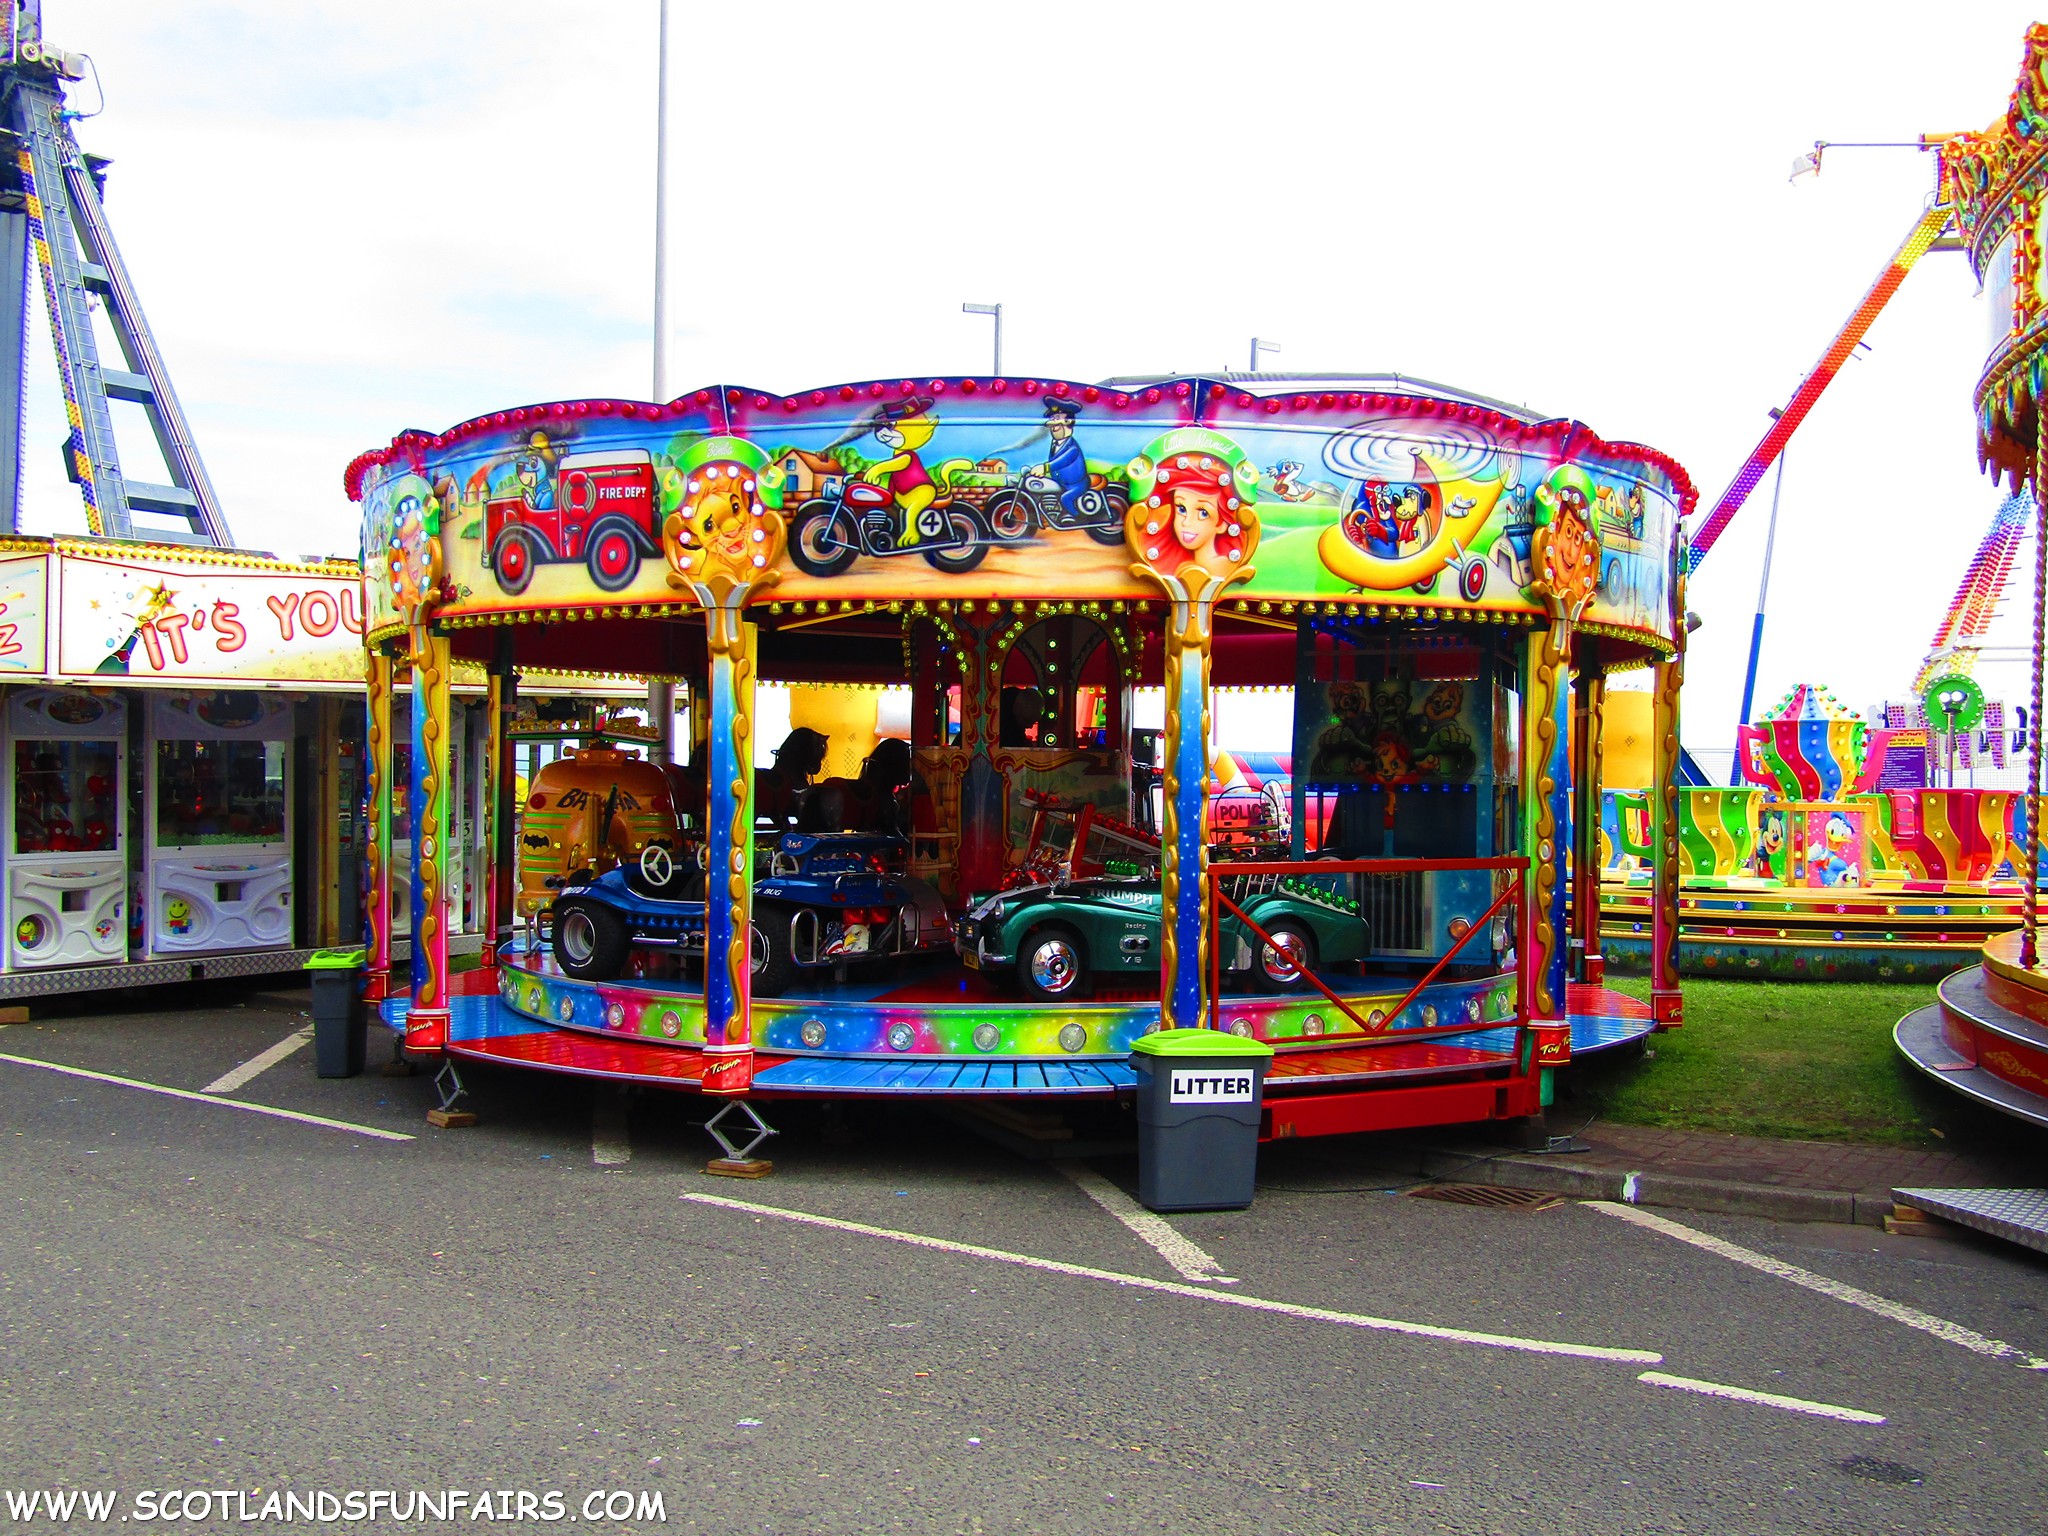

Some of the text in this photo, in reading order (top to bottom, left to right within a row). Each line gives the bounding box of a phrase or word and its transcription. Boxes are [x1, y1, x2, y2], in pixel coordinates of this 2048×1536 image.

[600, 486, 622, 500] FIRE
[1081, 493, 1095, 511] 6
[921, 512, 940, 533] 4
[140, 602, 248, 672] IT'S
[1219, 802, 1272, 821] POLICE
[1089, 887, 1154, 906] TRIUMPH
[1173, 1077, 1250, 1095] LITTER
